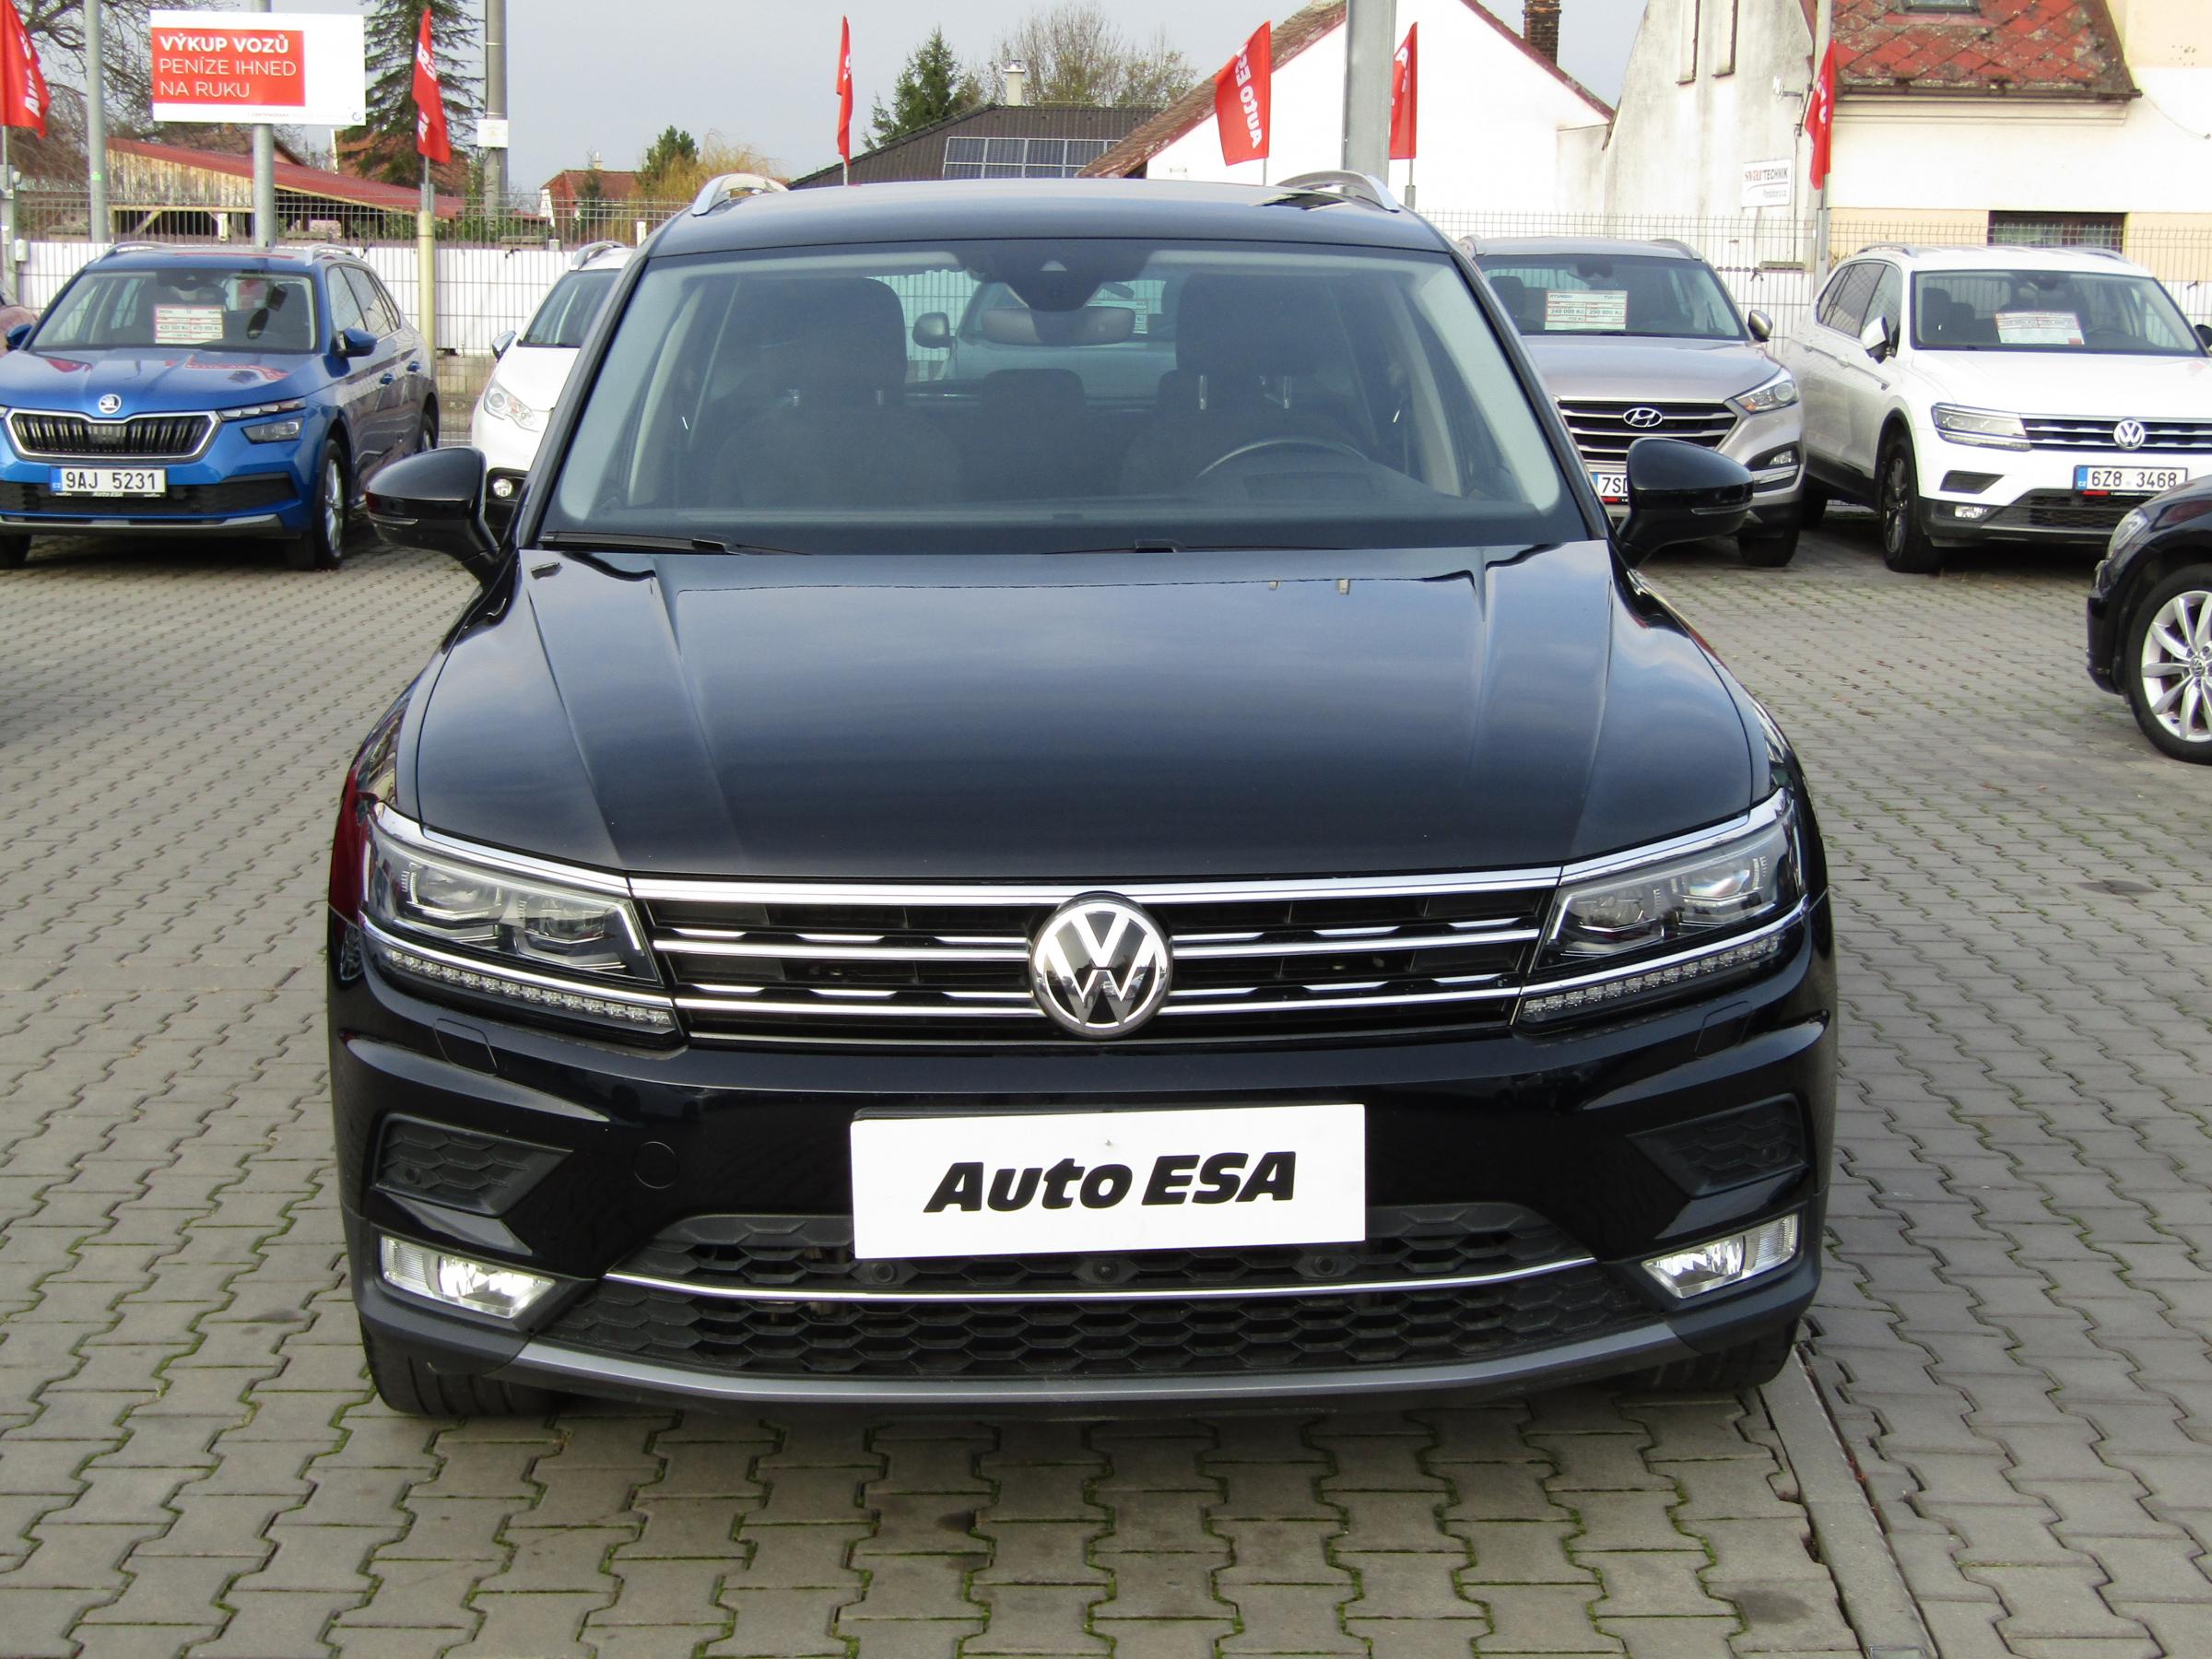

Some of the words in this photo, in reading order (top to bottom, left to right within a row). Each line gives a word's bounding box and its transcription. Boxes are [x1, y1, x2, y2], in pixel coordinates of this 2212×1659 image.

[159, 33, 228, 53] VÝKUP
[233, 34, 289, 53] VOZŮ
[159, 56, 229, 75] PENÍZE
[236, 60, 297, 76] IHNED
[159, 81, 190, 96] NA
[196, 81, 251, 98] RUKU
[65, 471, 98, 489] 9AJ
[112, 472, 155, 490] 5231
[2091, 470, 2123, 488] 6Z8
[2136, 471, 2177, 488] 3468
[923, 1158, 1134, 1213] Auto
[1141, 1150, 1297, 1206] ESA
